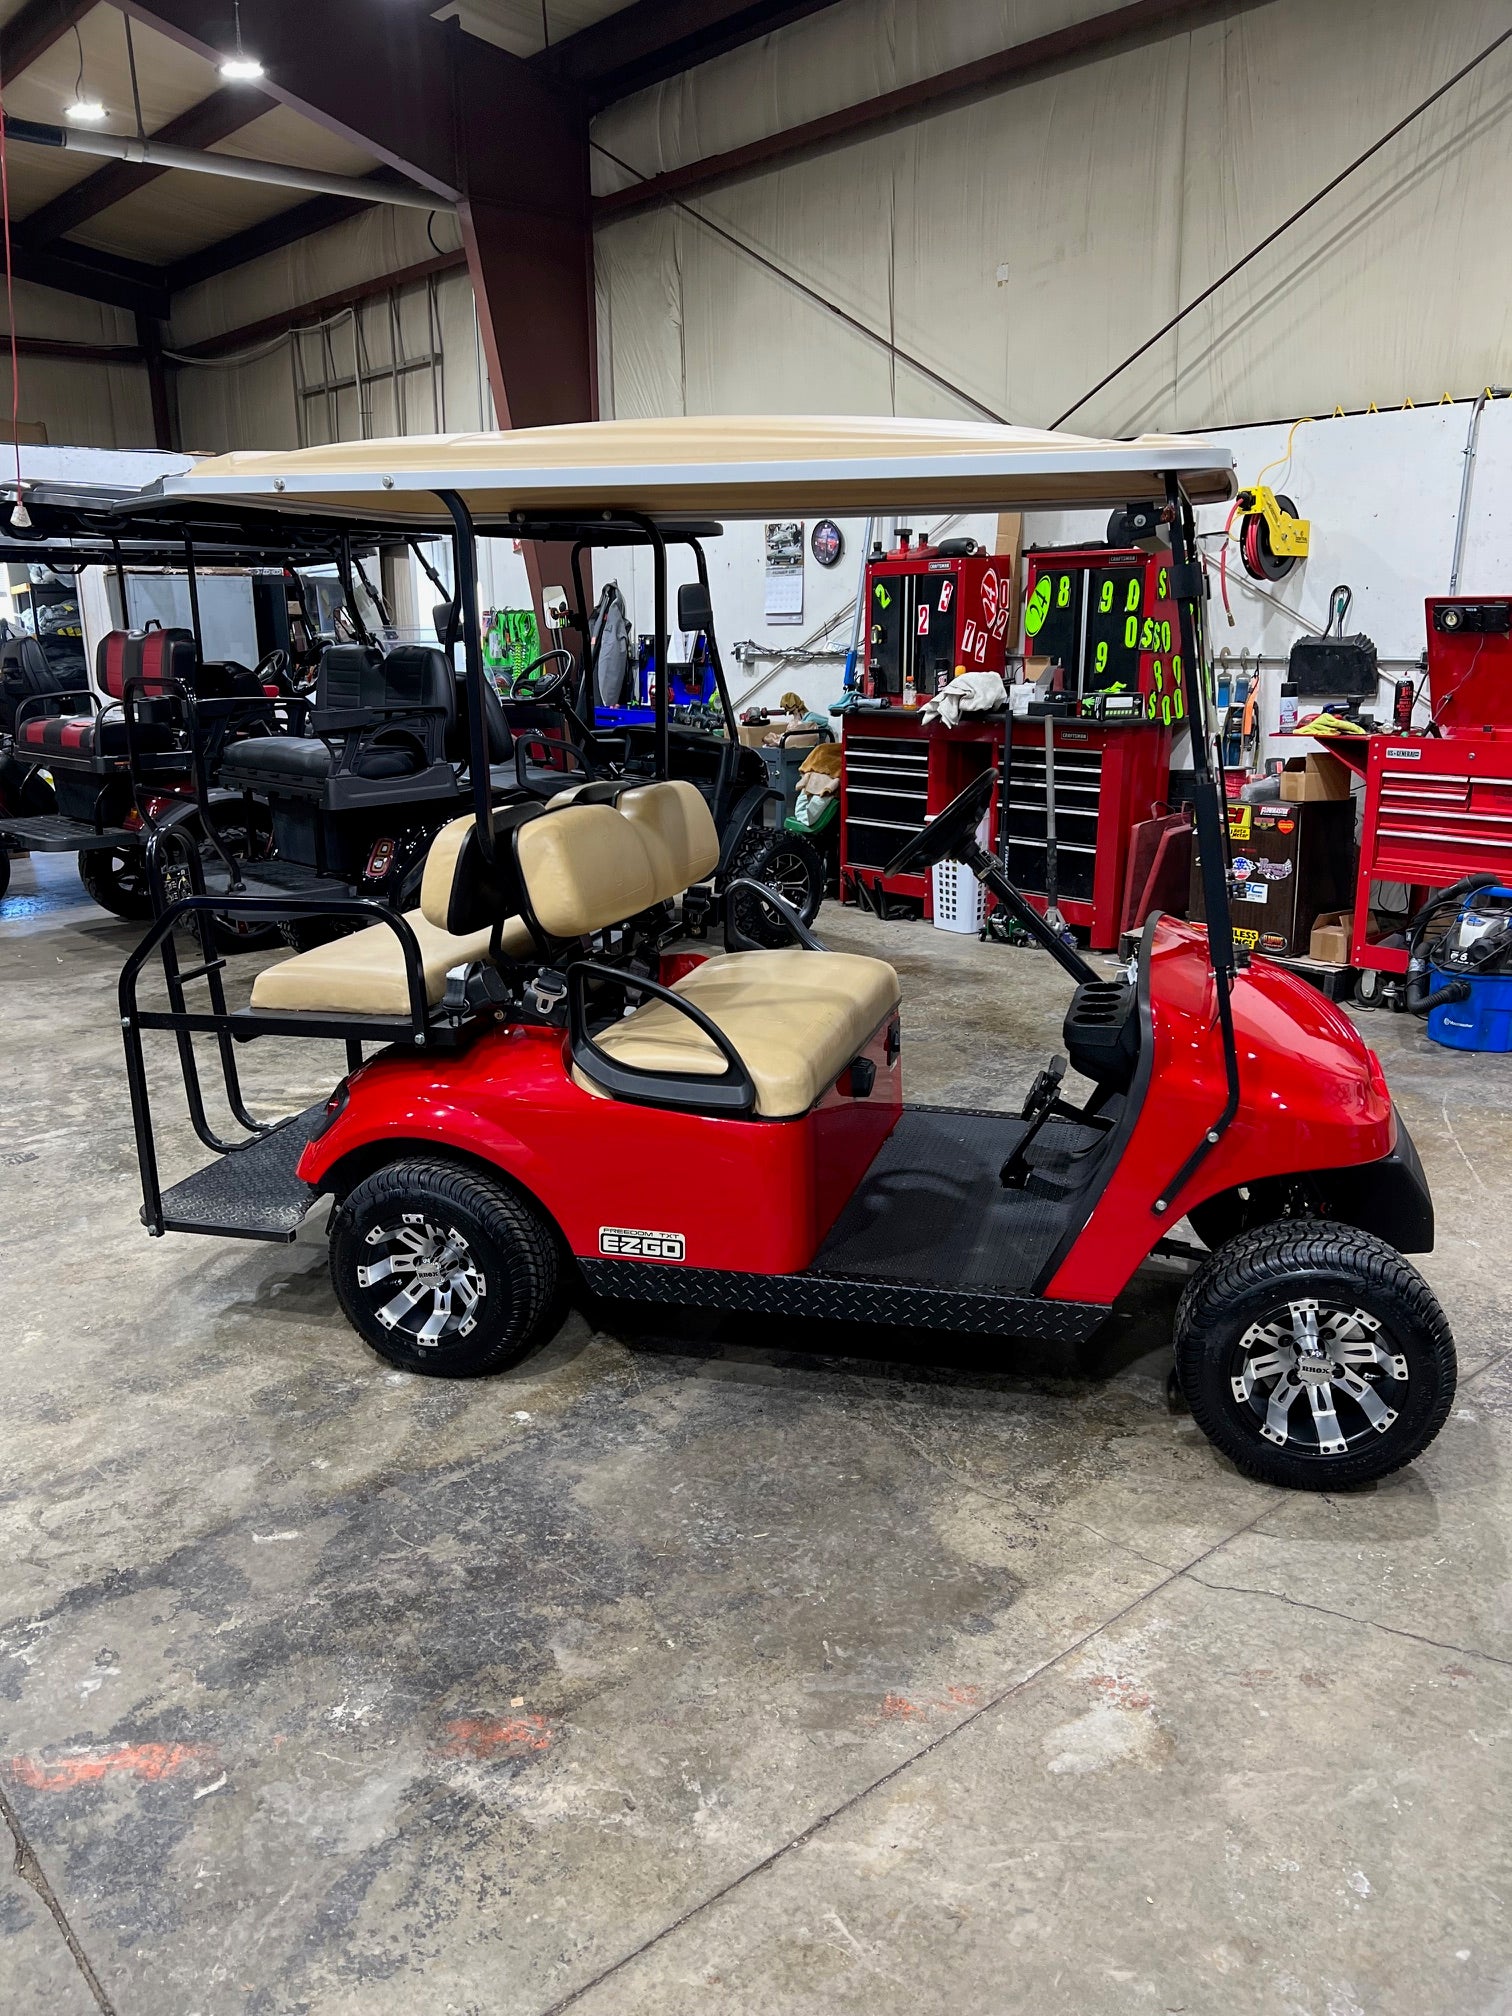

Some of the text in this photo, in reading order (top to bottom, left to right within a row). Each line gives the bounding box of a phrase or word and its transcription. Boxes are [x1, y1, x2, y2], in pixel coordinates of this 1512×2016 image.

[874, 584, 891, 609] 2
[940, 582, 953, 611] 3
[1058, 575, 1070, 607] 8
[1100, 581, 1114, 612] 9
[919, 606, 928, 635] 2
[994, 611, 1008, 638] 2
[964, 622, 976, 651] 7
[976, 633, 987, 661] 2
[1095, 642, 1108, 673] 9
[1233, 929, 1257, 940] LESS
[603, 1227, 653, 1237] FREEDOM
[602, 1235, 681, 1258] EZGO
